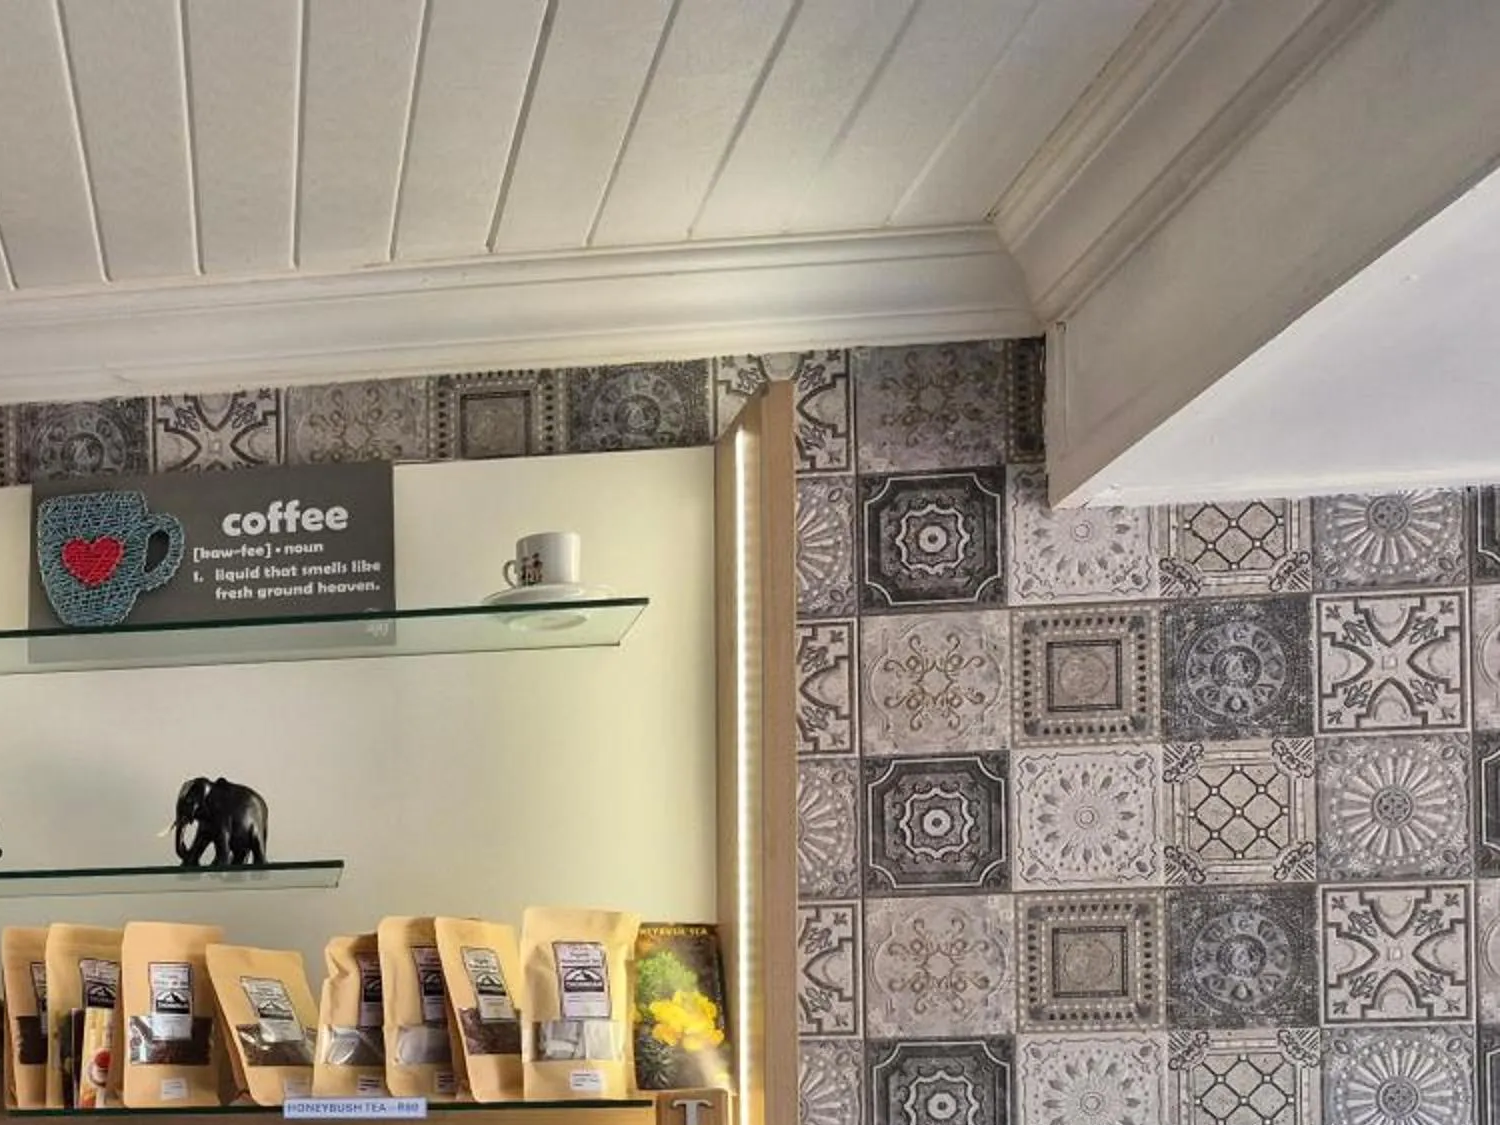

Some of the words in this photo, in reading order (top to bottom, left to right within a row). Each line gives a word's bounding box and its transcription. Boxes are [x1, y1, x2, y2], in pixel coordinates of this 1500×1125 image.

[222, 500, 349, 537] coffee
[284, 543, 323, 555] noun
[215, 565, 260, 584] liquid
[263, 564, 298, 578] that
[302, 562, 347, 576] smells
[351, 559, 381, 573] like
[215, 585, 253, 600] fresh
[257, 581, 313, 599] ground
[317, 580, 380, 594] heaven.
[287, 1102, 363, 1114] HONEYBUSH
[365, 1102, 387, 1113] TEA
